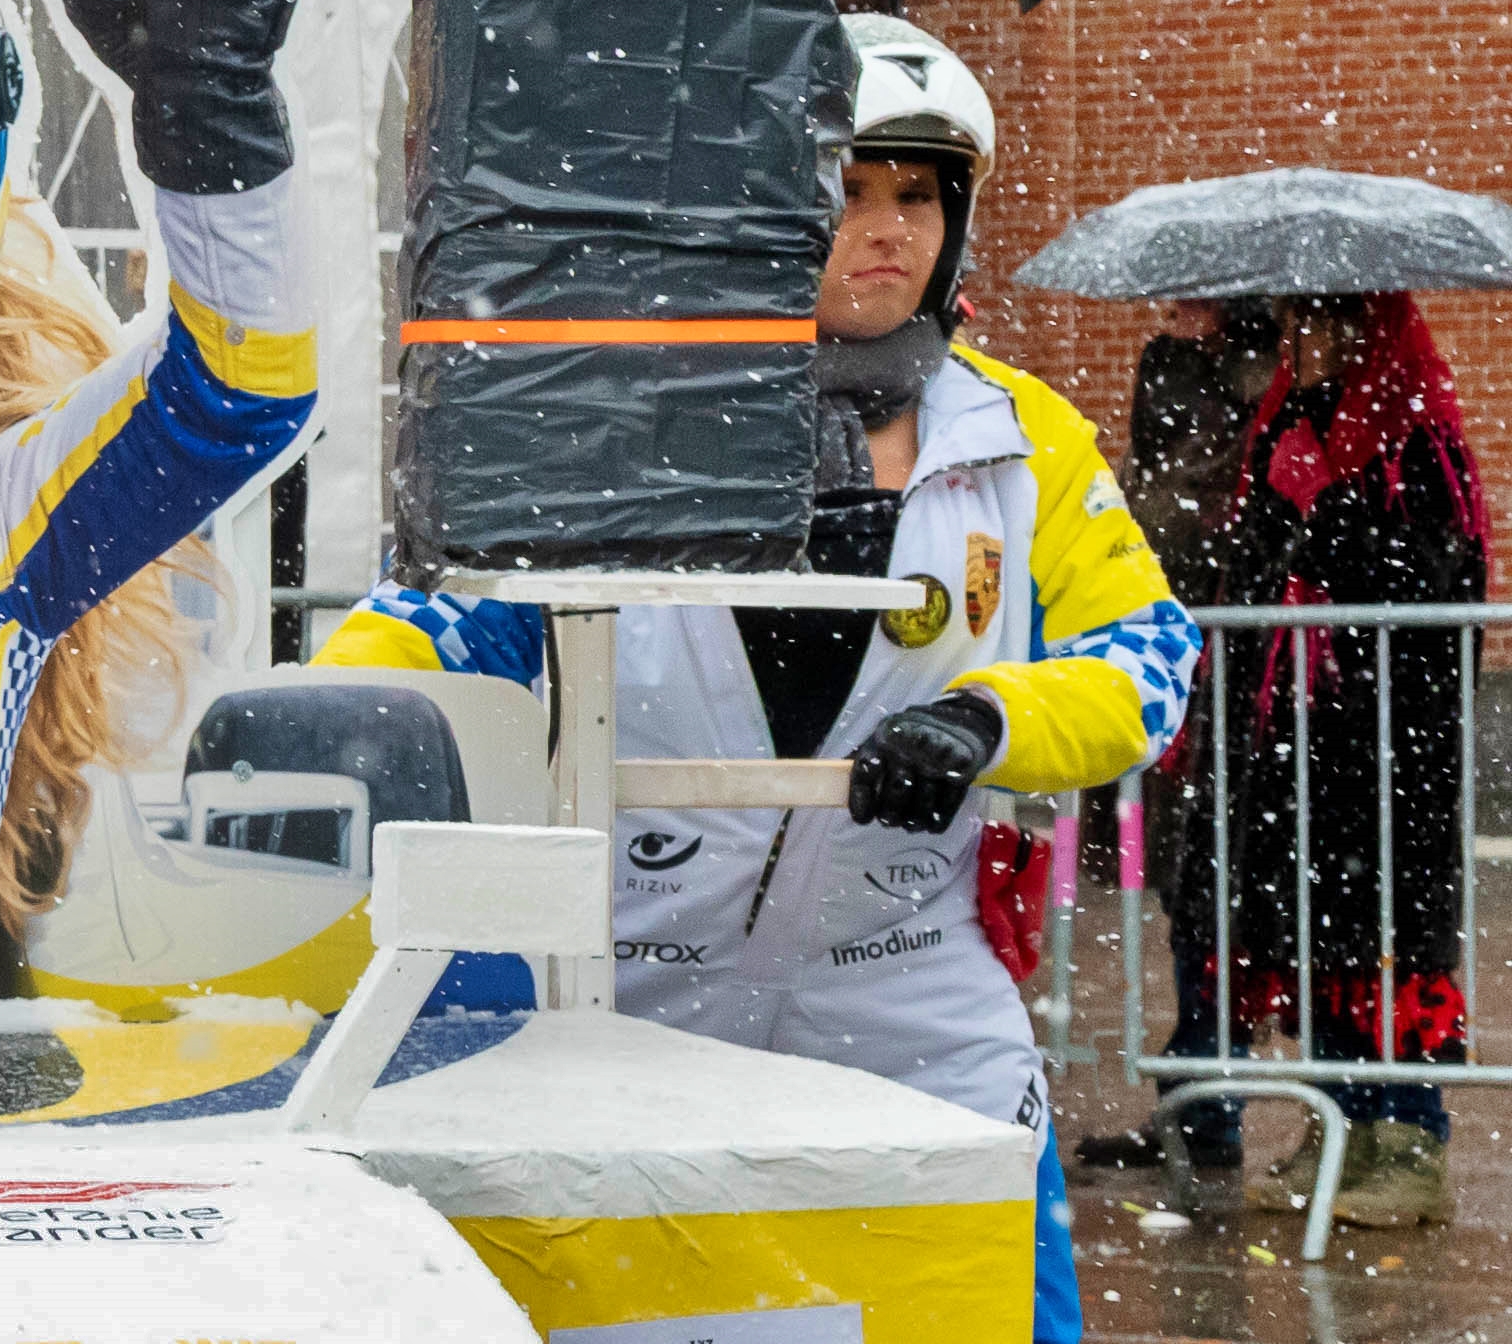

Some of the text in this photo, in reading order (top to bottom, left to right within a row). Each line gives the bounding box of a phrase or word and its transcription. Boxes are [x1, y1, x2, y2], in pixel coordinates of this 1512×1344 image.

[886, 863, 939, 885] TENA
[626, 878, 682, 895] RIZIV
[614, 941, 710, 965] OTOX
[831, 928, 943, 967] Imodium
